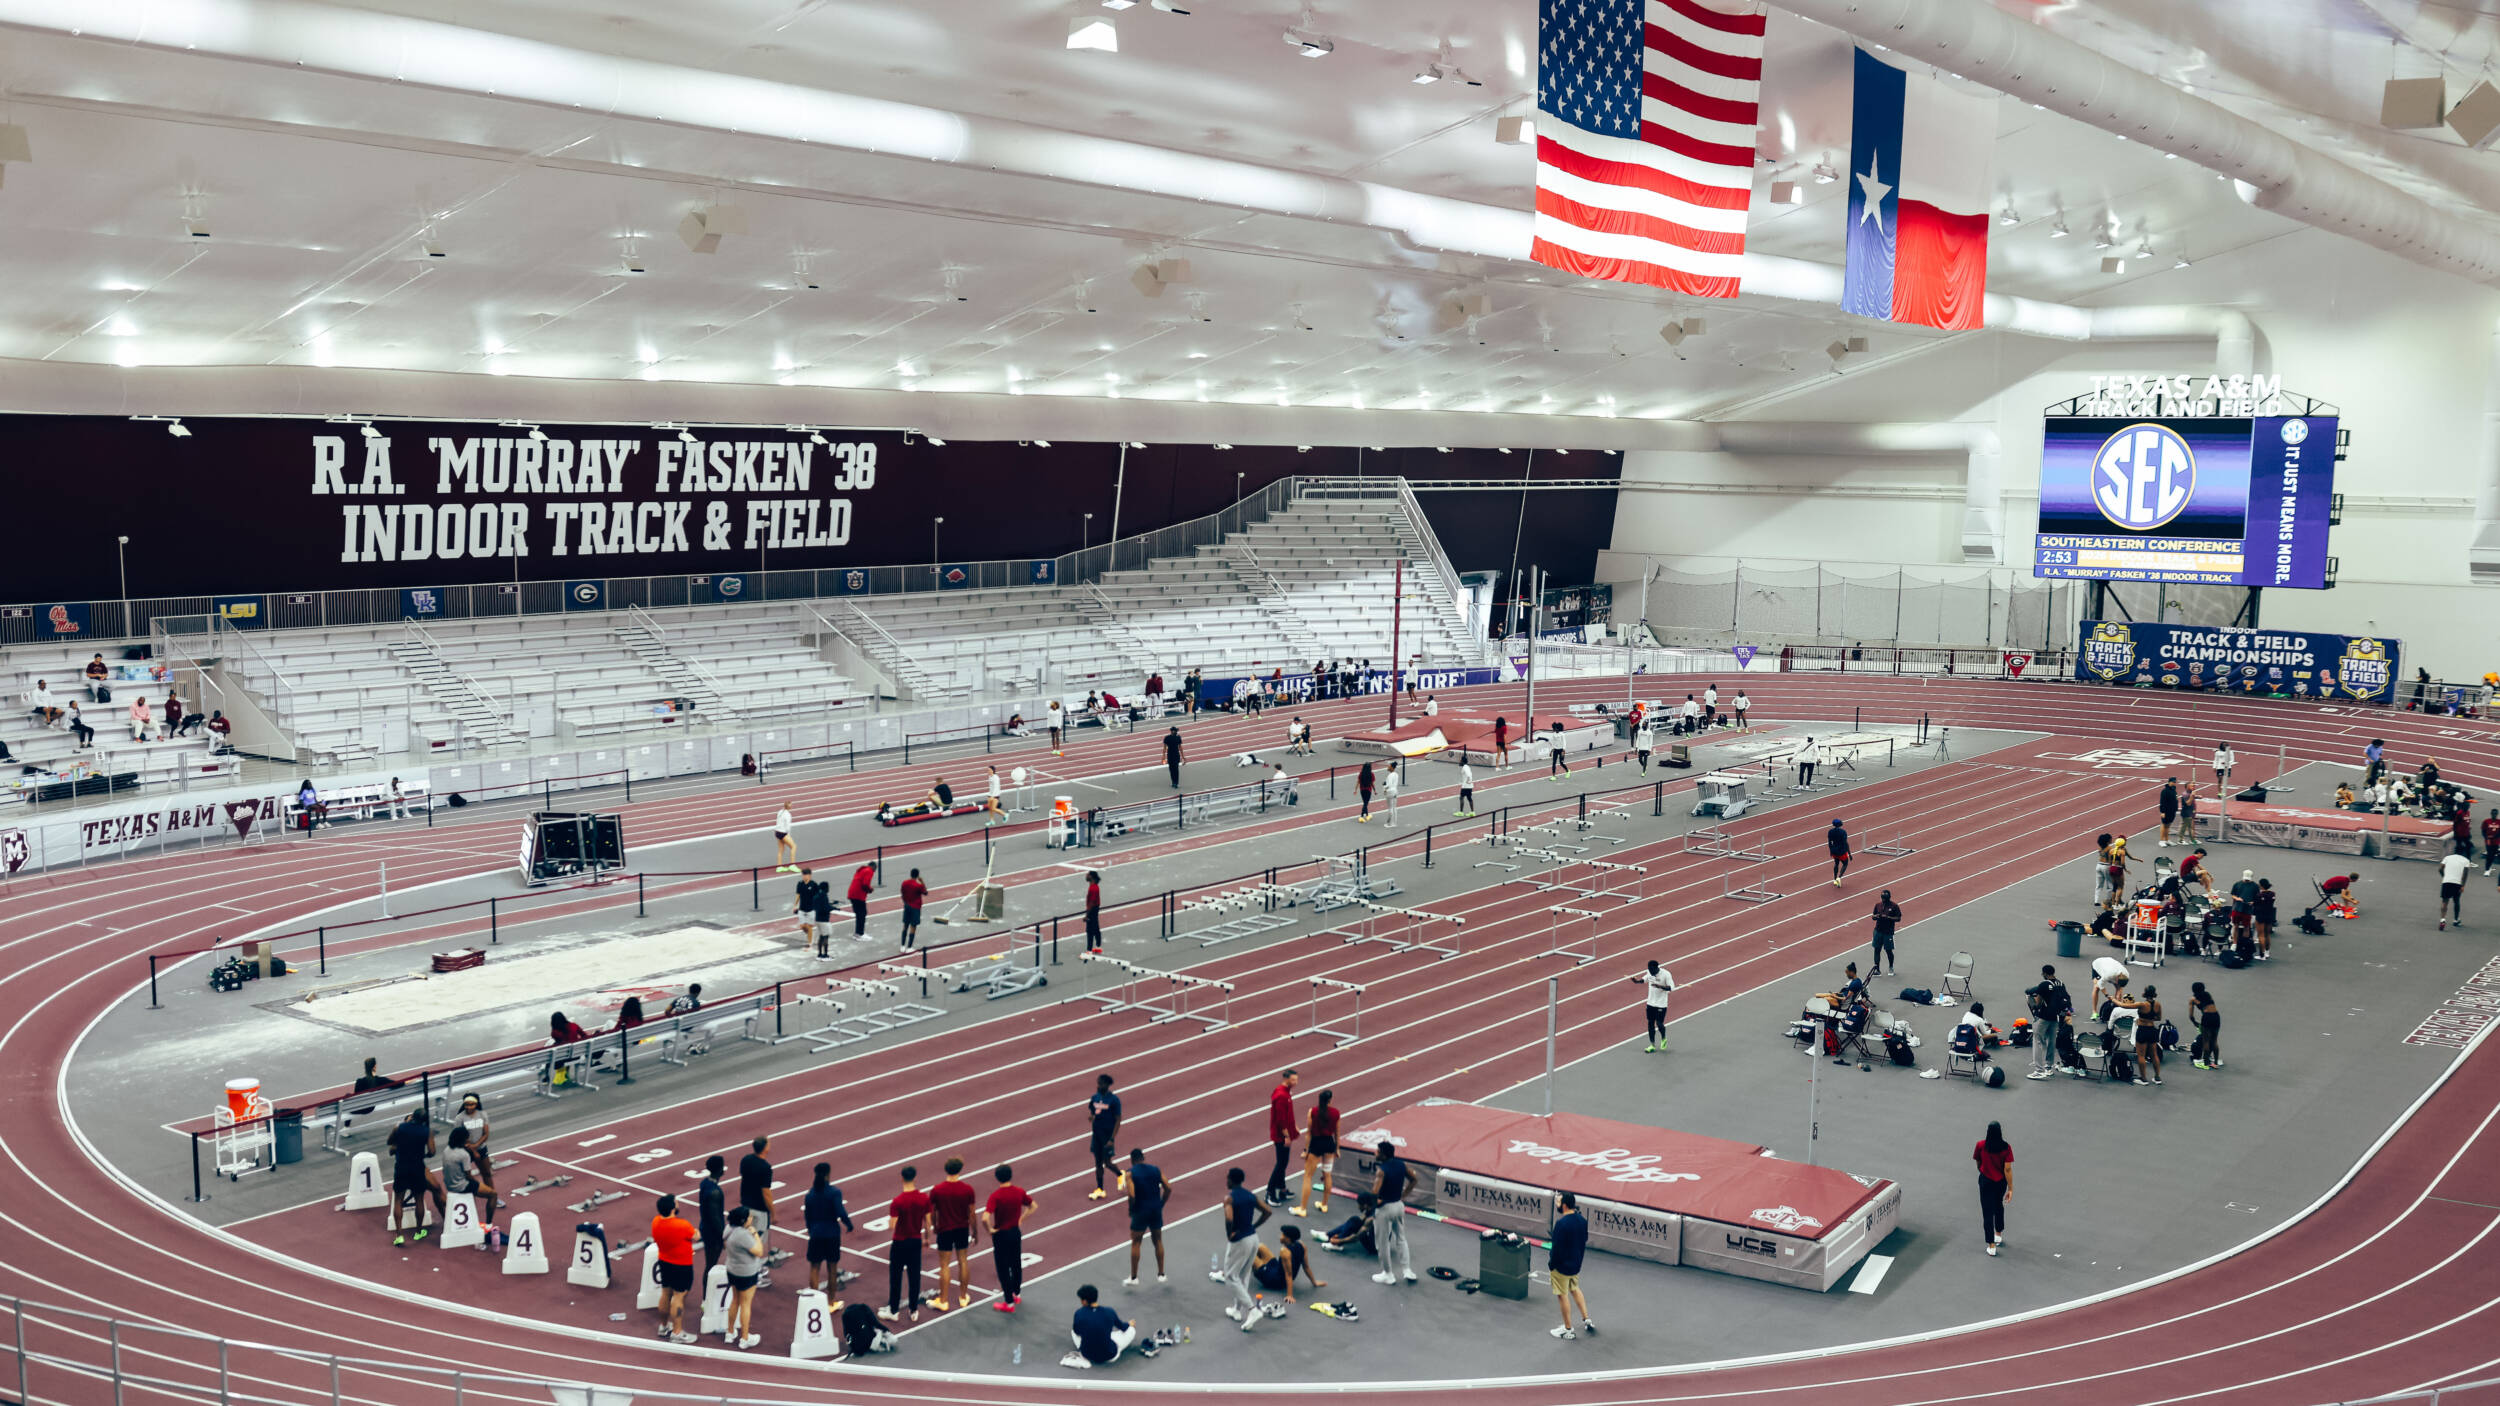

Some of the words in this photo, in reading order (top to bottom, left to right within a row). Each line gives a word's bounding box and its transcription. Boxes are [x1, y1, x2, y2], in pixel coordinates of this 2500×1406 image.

[2089, 374, 2190, 399] TEXAS
[2201, 373, 2282, 399] A&M
[2088, 400, 2158, 417] TRACK
[2161, 400, 2212, 417] AND
[2220, 400, 2282, 417] FIELD
[2285, 446, 2301, 459] IT
[312, 435, 405, 494] R.A.
[655, 440, 813, 492] FASKEN
[829, 442, 877, 490] '38
[2099, 430, 2189, 523] SEC
[2282, 461, 2299, 493] JUST
[2279, 496, 2296, 541] MEANS
[341, 502, 529, 562] INDOOR
[546, 500, 691, 554] TRACK
[703, 500, 732, 550] &
[744, 498, 852, 549] FIELD
[2040, 537, 2145, 550] SOUTHEASTERN
[2148, 540, 2241, 553] CONFERENCE
[2042, 551, 2072, 564] 2:53
[2275, 544, 2292, 585] MORE.
[2043, 567, 2062, 576] R.A.
[2110, 570, 2146, 579] FASKEN
[2162, 572, 2198, 581] INDOOR
[2200, 573, 2233, 582] TRACK
[49, 606, 67, 620] Ole
[220, 603, 257, 618] LSU
[54, 619, 79, 633] Miss
[2219, 626, 2258, 635] INDOOR
[2087, 641, 2132, 654] TRACK
[2169, 630, 2232, 648] TRACK
[2236, 635, 2248, 648] &
[2254, 636, 2308, 651] FIELD
[2087, 652, 2096, 661] &
[2098, 652, 2132, 665] FIELD
[2159, 645, 2315, 667] CHAMPIONSHIPS
[2341, 658, 2388, 673] TRACK
[2341, 670, 2351, 681] &
[2352, 671, 2386, 684] FIELD
[83, 812, 161, 848] TEXAS
[167, 804, 215, 831] A&M
[2401, 1009, 2494, 1049] TEXAS
[577, 1134, 618, 1147] 1
[626, 1148, 673, 1164] 2
[360, 1166, 372, 1188] 1
[402, 1189, 416, 1207] 2
[1472, 1186, 1512, 1203] TEXAS
[1516, 1194, 1542, 1209] A&M
[453, 1203, 469, 1226] 3
[1594, 1209, 1637, 1228] TEXAS
[1640, 1218, 1668, 1234] A&M
[516, 1229, 532, 1251] 4
[1727, 1233, 1777, 1254] UCS
[579, 1240, 593, 1264] 5
[716, 1283, 731, 1308] 7
[807, 1308, 822, 1334] 8
